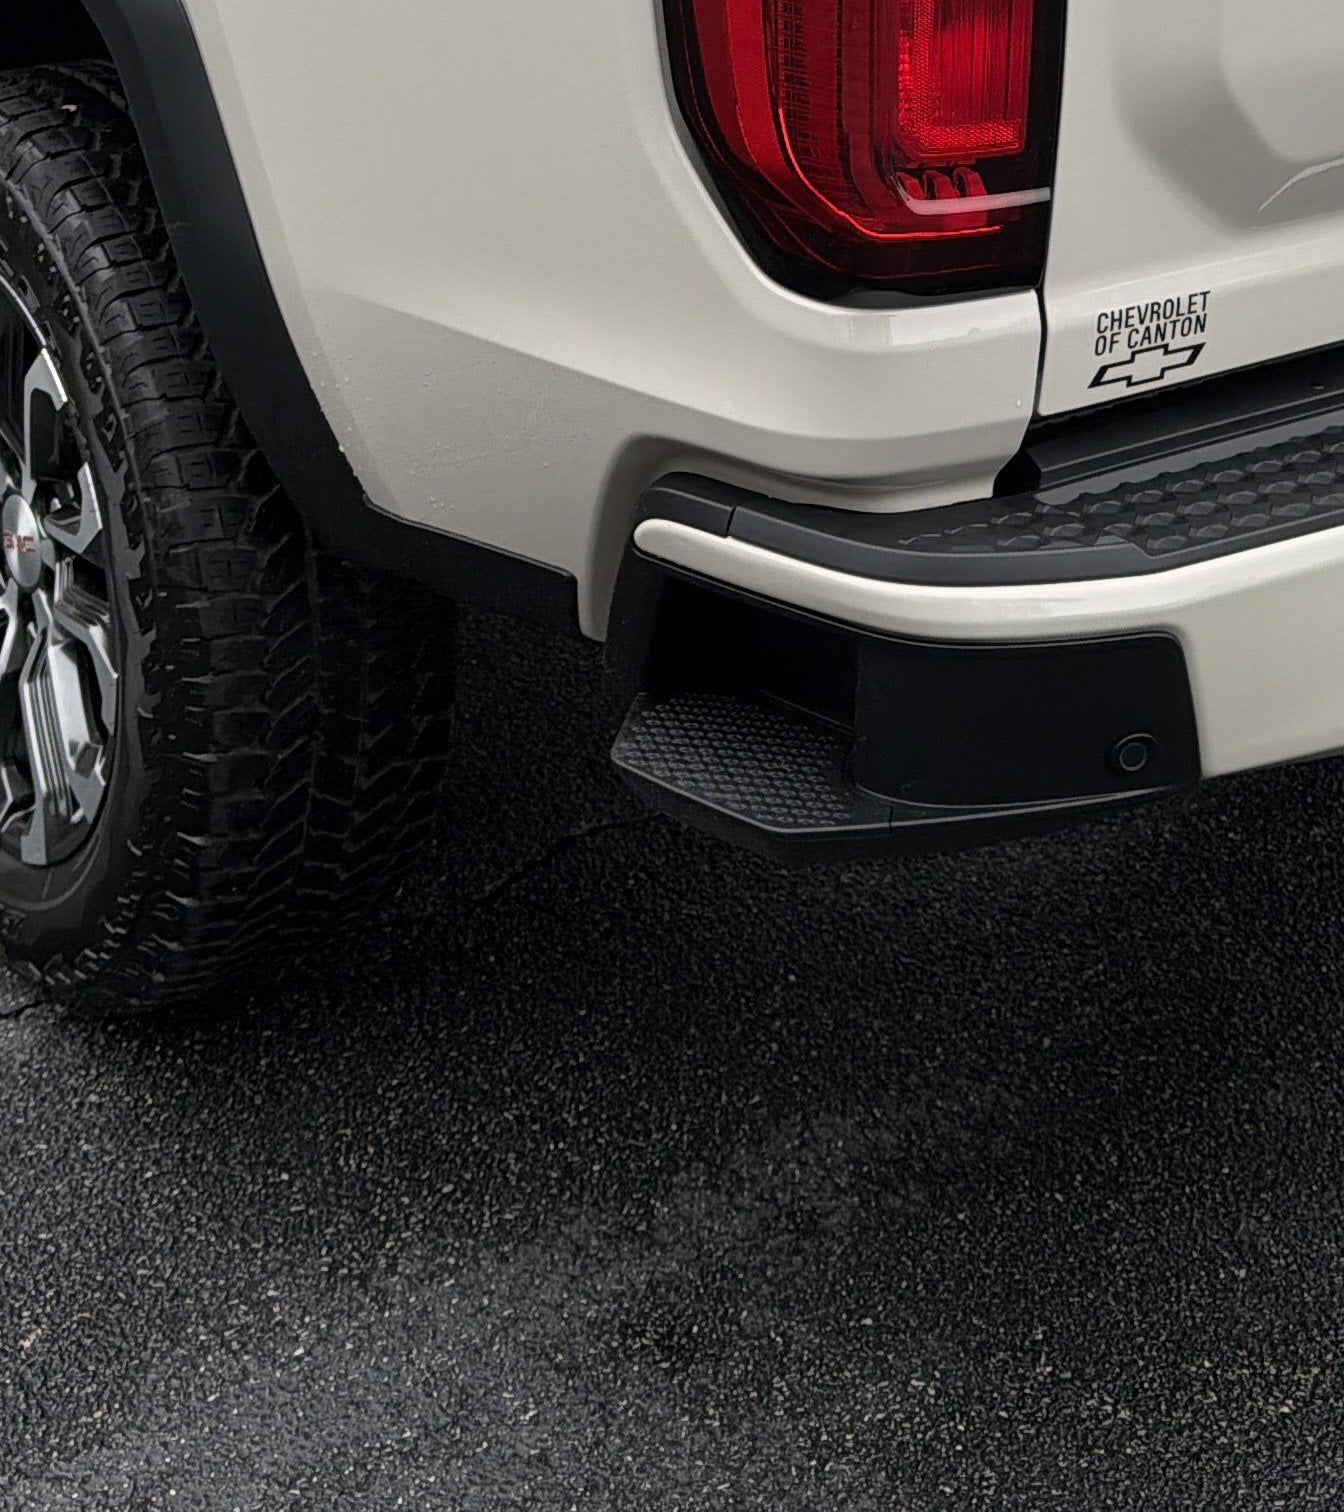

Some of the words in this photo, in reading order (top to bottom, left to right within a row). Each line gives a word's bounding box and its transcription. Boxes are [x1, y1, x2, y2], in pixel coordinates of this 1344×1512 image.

[1094, 332, 1121, 356] OF
[1127, 313, 1208, 349] CANTON
[1096, 290, 1211, 335] CHEVROLET
